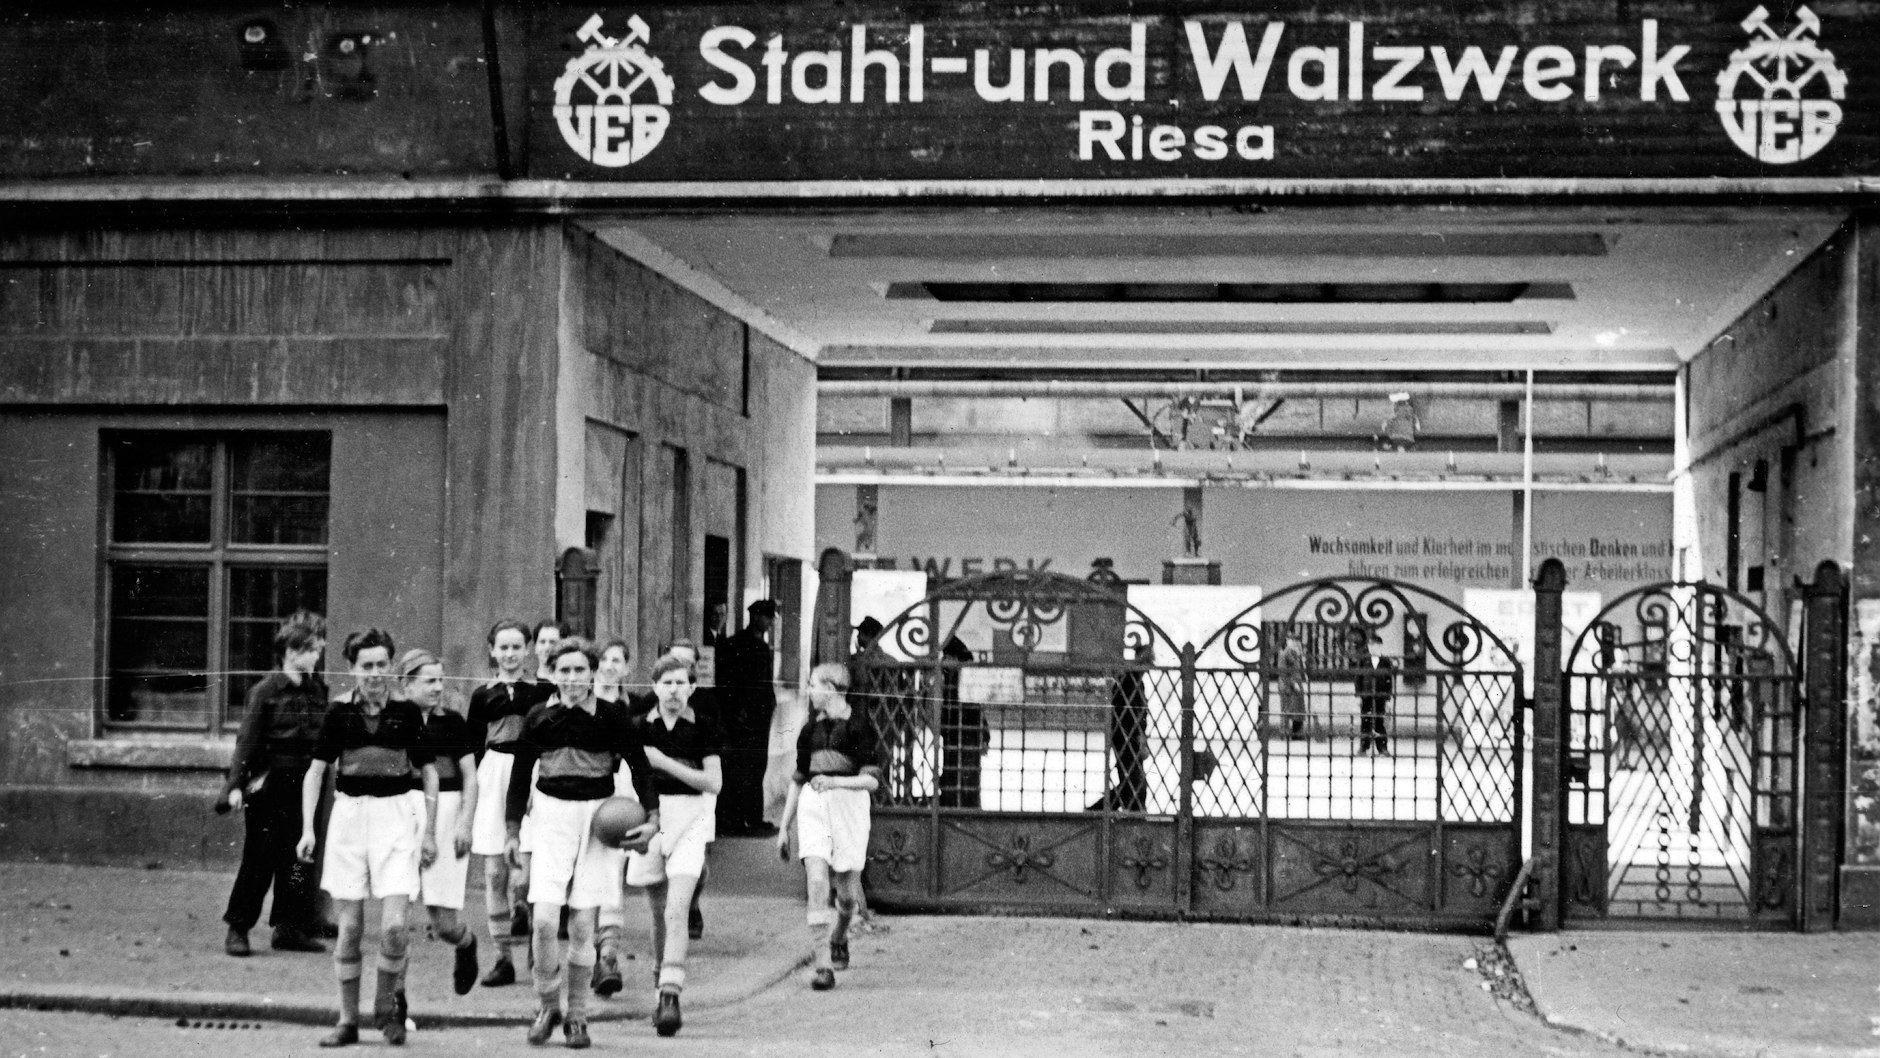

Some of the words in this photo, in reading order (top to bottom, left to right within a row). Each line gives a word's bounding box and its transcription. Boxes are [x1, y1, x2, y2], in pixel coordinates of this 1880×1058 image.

[1185, 20, 1690, 101] Walzwerk
[553, 104, 671, 168] VEB
[1079, 111, 1274, 161] Riesa
[1715, 99, 1843, 164] VEB
[1309, 535, 1393, 555] Wachsamkeit
[1397, 537, 1418, 555] und
[1423, 536, 1473, 556] Klarheit
[1477, 540, 1492, 556] im
[1590, 536, 1638, 558] Denken
[1642, 540, 1665, 557] und
[1423, 560, 1509, 583] erfolgreichen
[1584, 561, 1673, 580] Arbeiterklass
